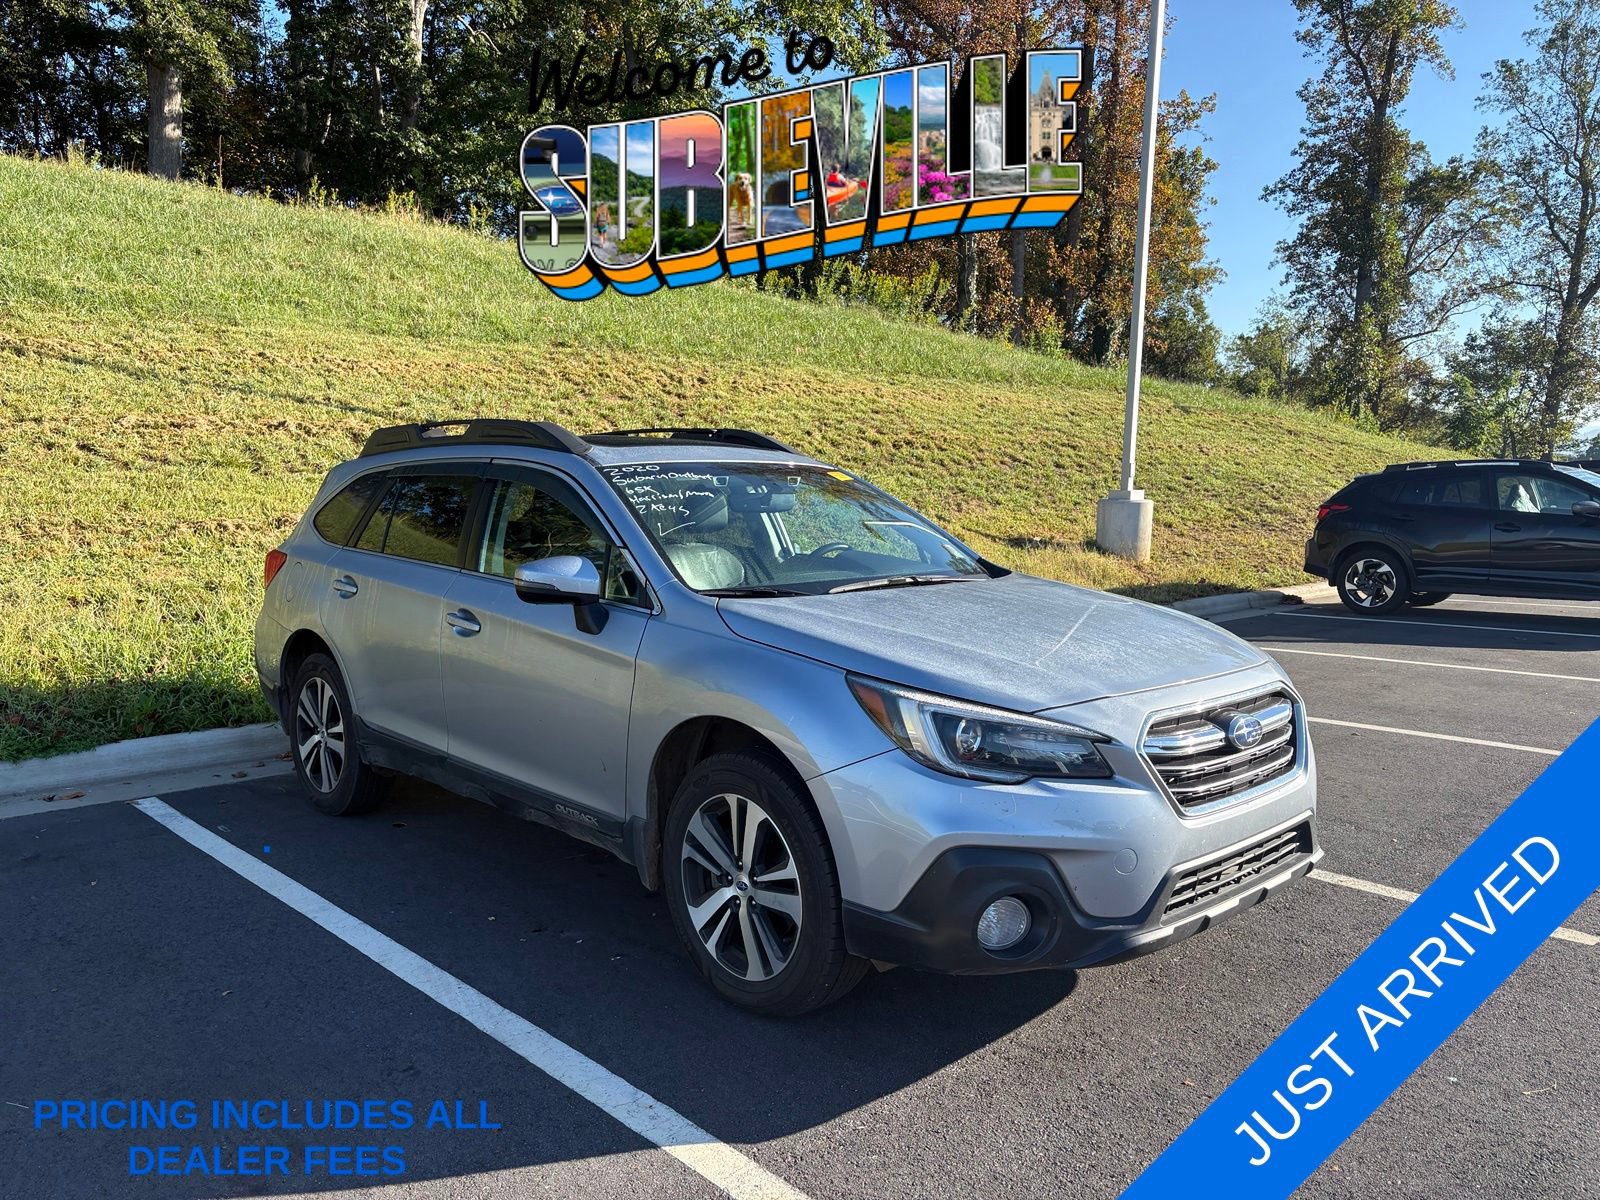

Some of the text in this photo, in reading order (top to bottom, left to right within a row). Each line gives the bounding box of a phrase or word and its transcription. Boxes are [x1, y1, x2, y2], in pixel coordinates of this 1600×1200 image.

[603, 464, 660, 476] 2020
[636, 505, 647, 514] 2
[555, 803, 600, 829] OUTBACK
